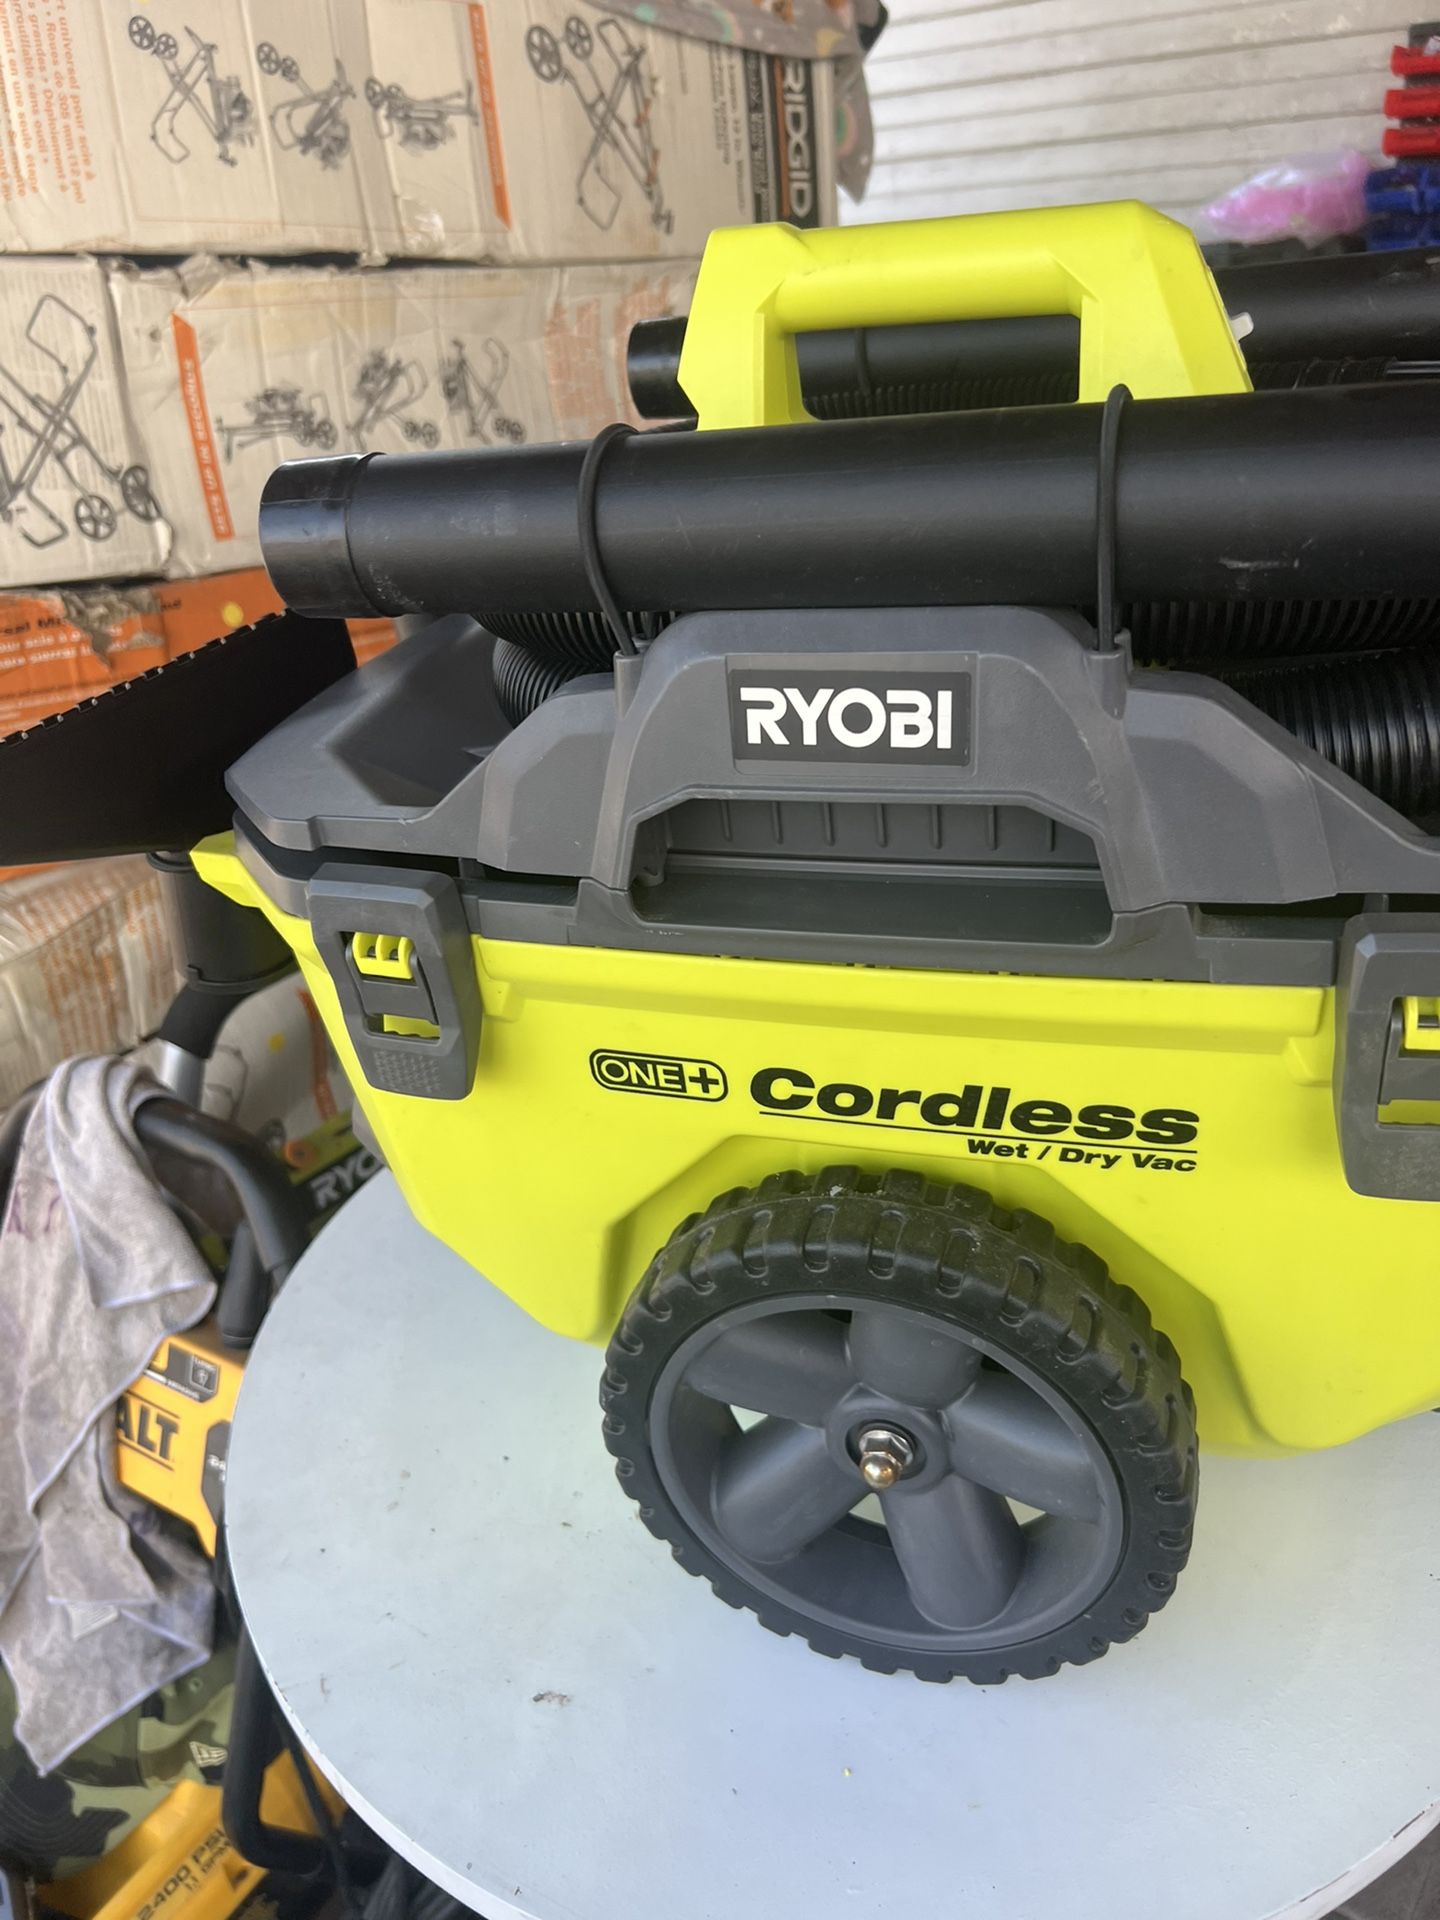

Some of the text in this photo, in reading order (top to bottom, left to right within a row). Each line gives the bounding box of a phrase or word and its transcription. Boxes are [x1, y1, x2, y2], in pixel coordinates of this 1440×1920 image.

[60, 16, 80, 89] universel
[783, 59, 813, 218] RIDGID
[740, 687, 952, 749] RYOBI
[750, 1067, 1200, 1145] Cordless
[967, 1139, 1198, 1172] Wet / Dry Vac
[137, 1865, 192, 1920] 2400
